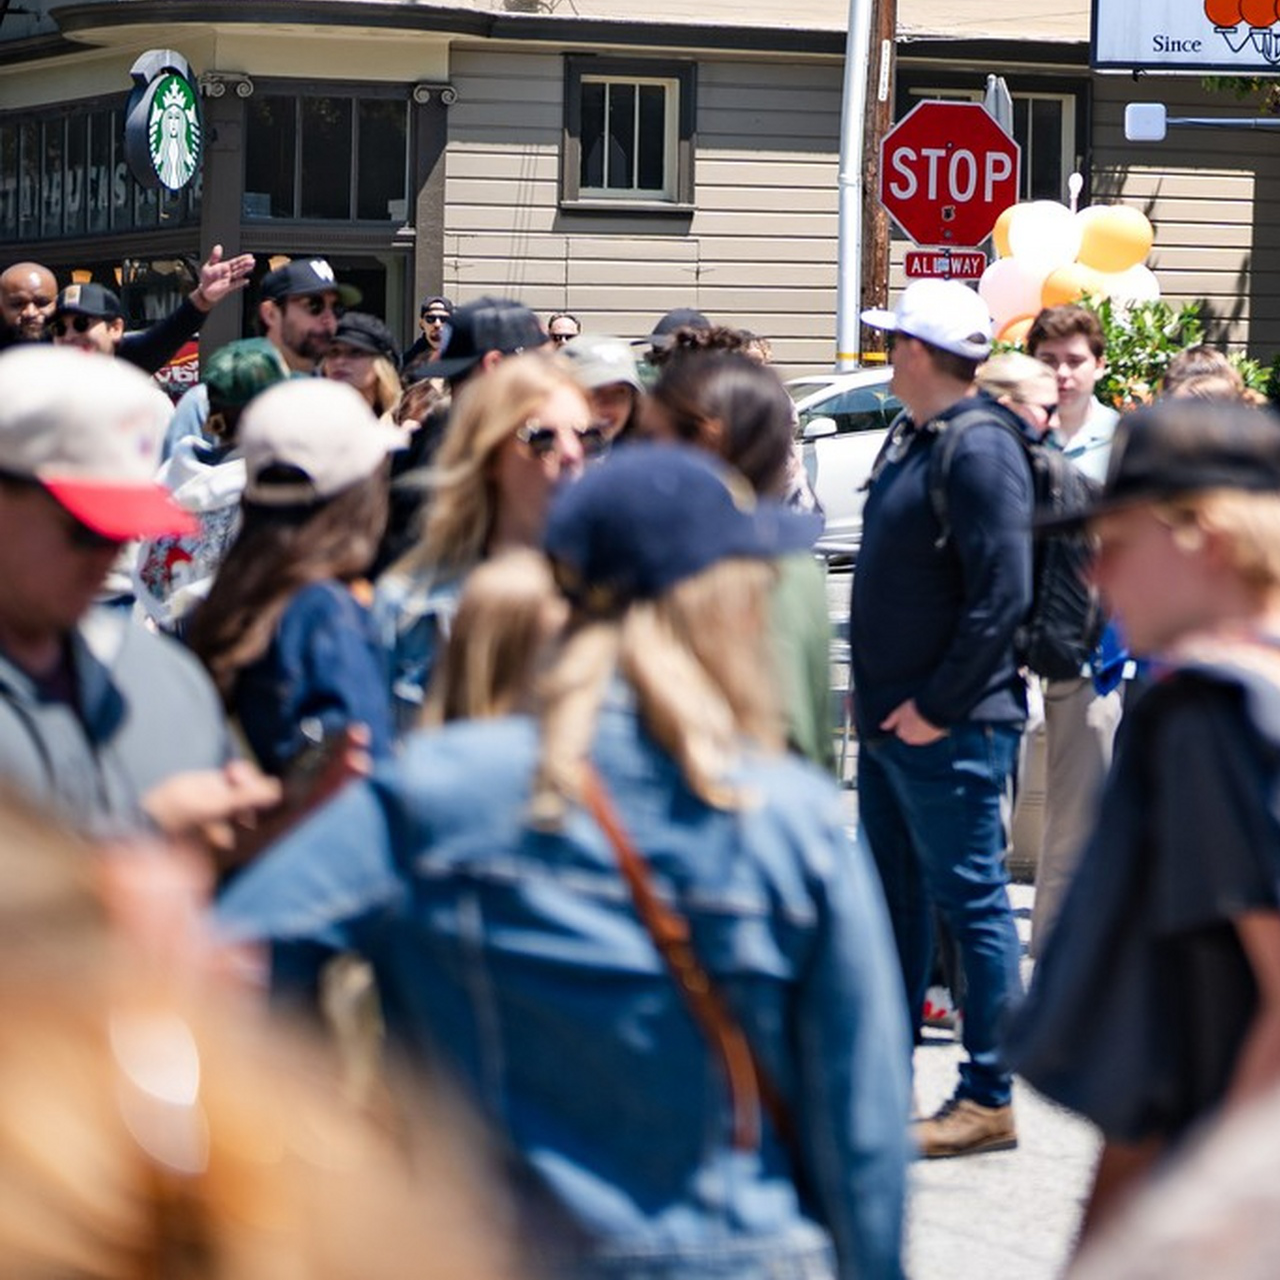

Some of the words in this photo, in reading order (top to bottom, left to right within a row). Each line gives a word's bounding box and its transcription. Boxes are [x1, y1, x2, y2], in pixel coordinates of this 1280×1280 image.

[1153, 35, 1201, 54] Since
[889, 147, 1012, 202] STOP
[951, 257, 980, 274] WAY
